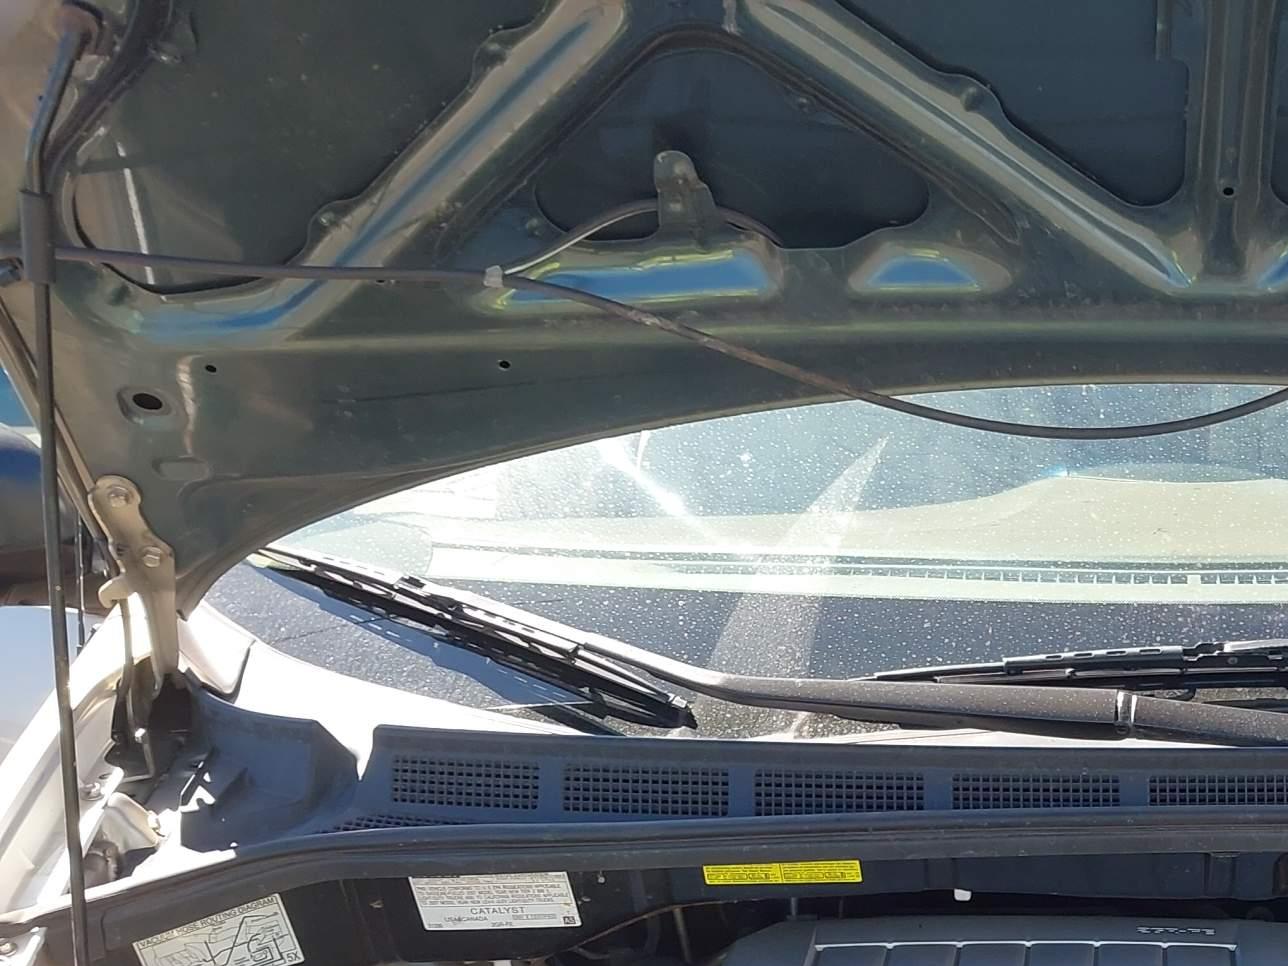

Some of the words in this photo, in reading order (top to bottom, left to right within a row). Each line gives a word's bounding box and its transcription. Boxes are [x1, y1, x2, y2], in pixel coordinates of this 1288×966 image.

[201, 909, 237, 928] ROUTING
[237, 897, 276, 915] DIAGRAM
[470, 906, 526, 915] CATALYST
[287, 952, 301, 963] 5X
